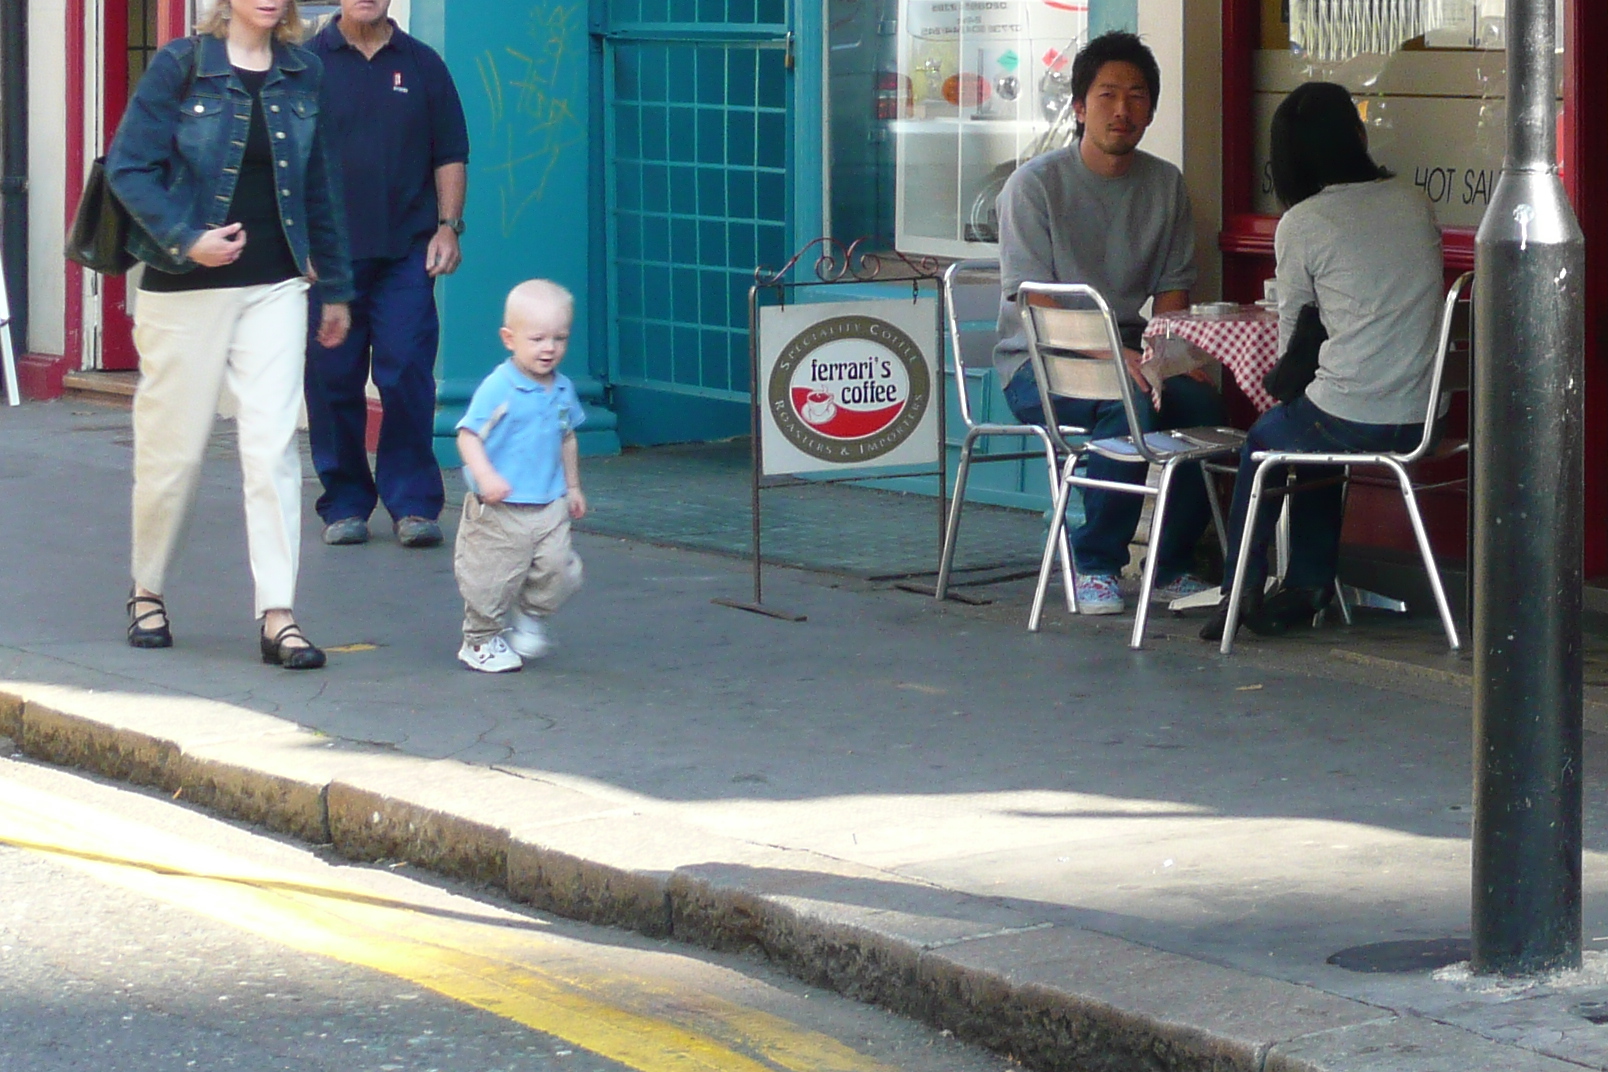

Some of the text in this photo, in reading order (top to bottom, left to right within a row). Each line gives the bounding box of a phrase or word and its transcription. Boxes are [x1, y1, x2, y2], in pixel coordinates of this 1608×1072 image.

[1414, 165, 1457, 204] HOT
[779, 323, 918, 371] SPECIALITY COFFEE
[810, 356, 892, 382] ferrari's
[841, 380, 897, 405] coffee
[774, 393, 923, 456] ROASTERS & IMPORTERS
